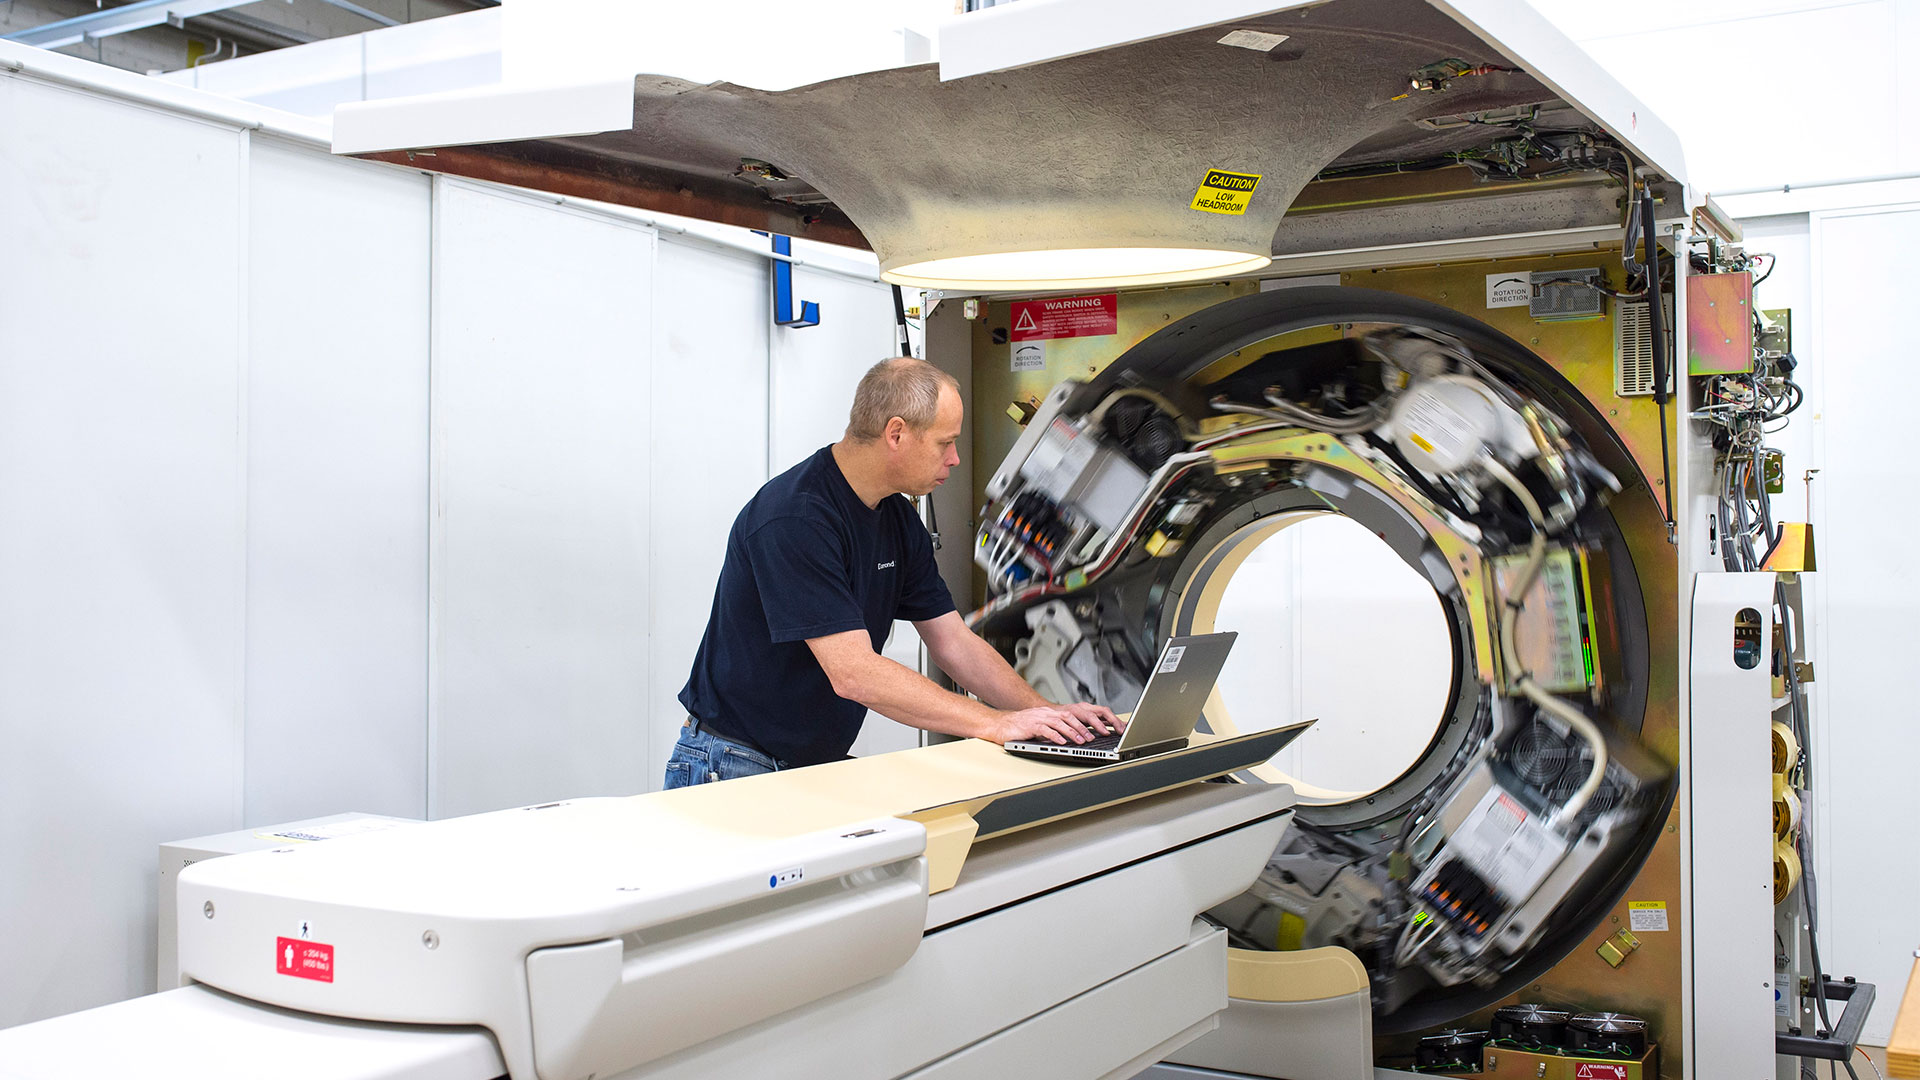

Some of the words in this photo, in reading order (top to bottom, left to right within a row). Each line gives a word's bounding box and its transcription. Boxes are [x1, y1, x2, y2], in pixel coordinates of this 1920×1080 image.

[1209, 174, 1255, 190] CAUTION
[1215, 191, 1236, 202] LOW
[1196, 198, 1244, 212] HEADROOM
[1493, 288, 1527, 297] ROTATION
[1044, 298, 1102, 310] WARNING
[1491, 294, 1529, 303] DIRECTION
